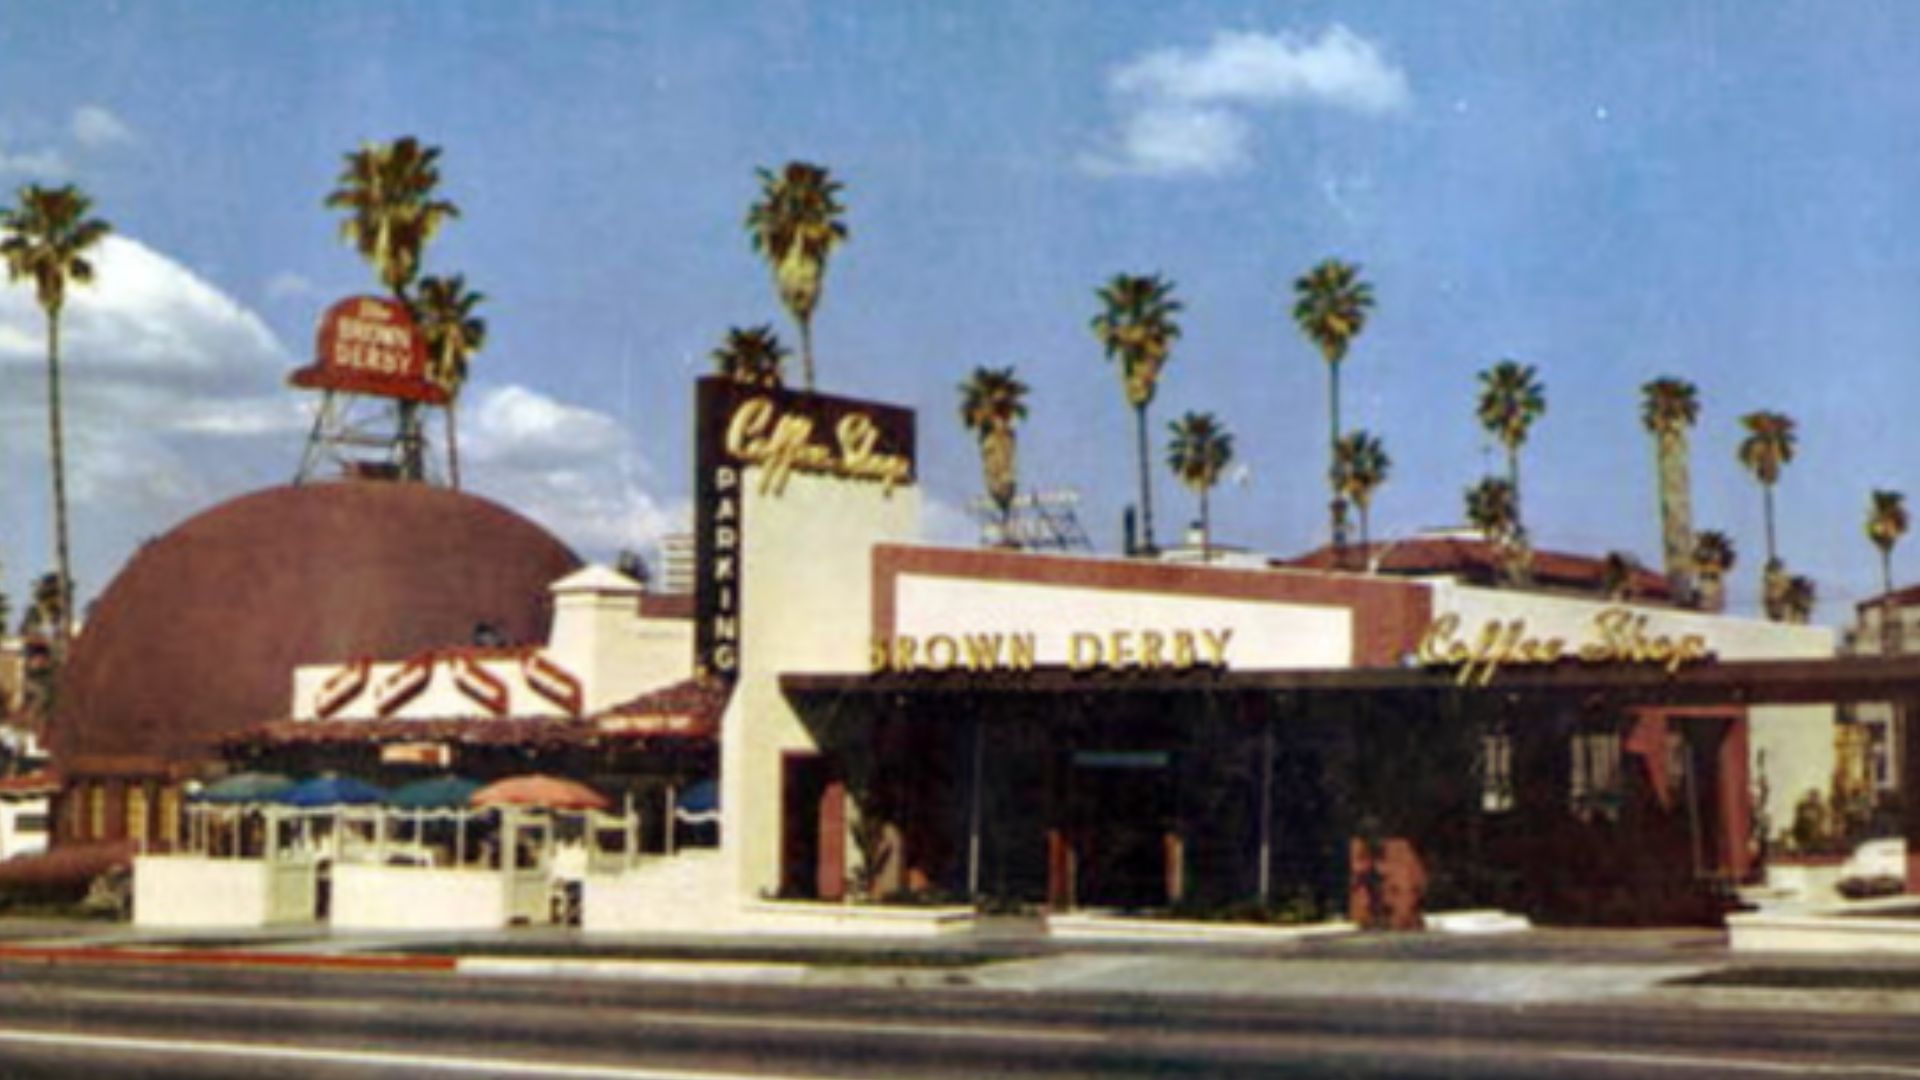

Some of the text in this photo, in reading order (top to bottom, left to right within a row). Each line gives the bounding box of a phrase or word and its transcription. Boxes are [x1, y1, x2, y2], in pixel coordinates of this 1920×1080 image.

[336, 343, 413, 373] DERBY
[338, 318, 411, 347] BROWN
[726, 396, 830, 497] Coffee
[715, 467, 736, 669] PARKING
[870, 629, 1233, 672] BROWN DERBY
[1418, 606, 1706, 686] Coffee Shop
